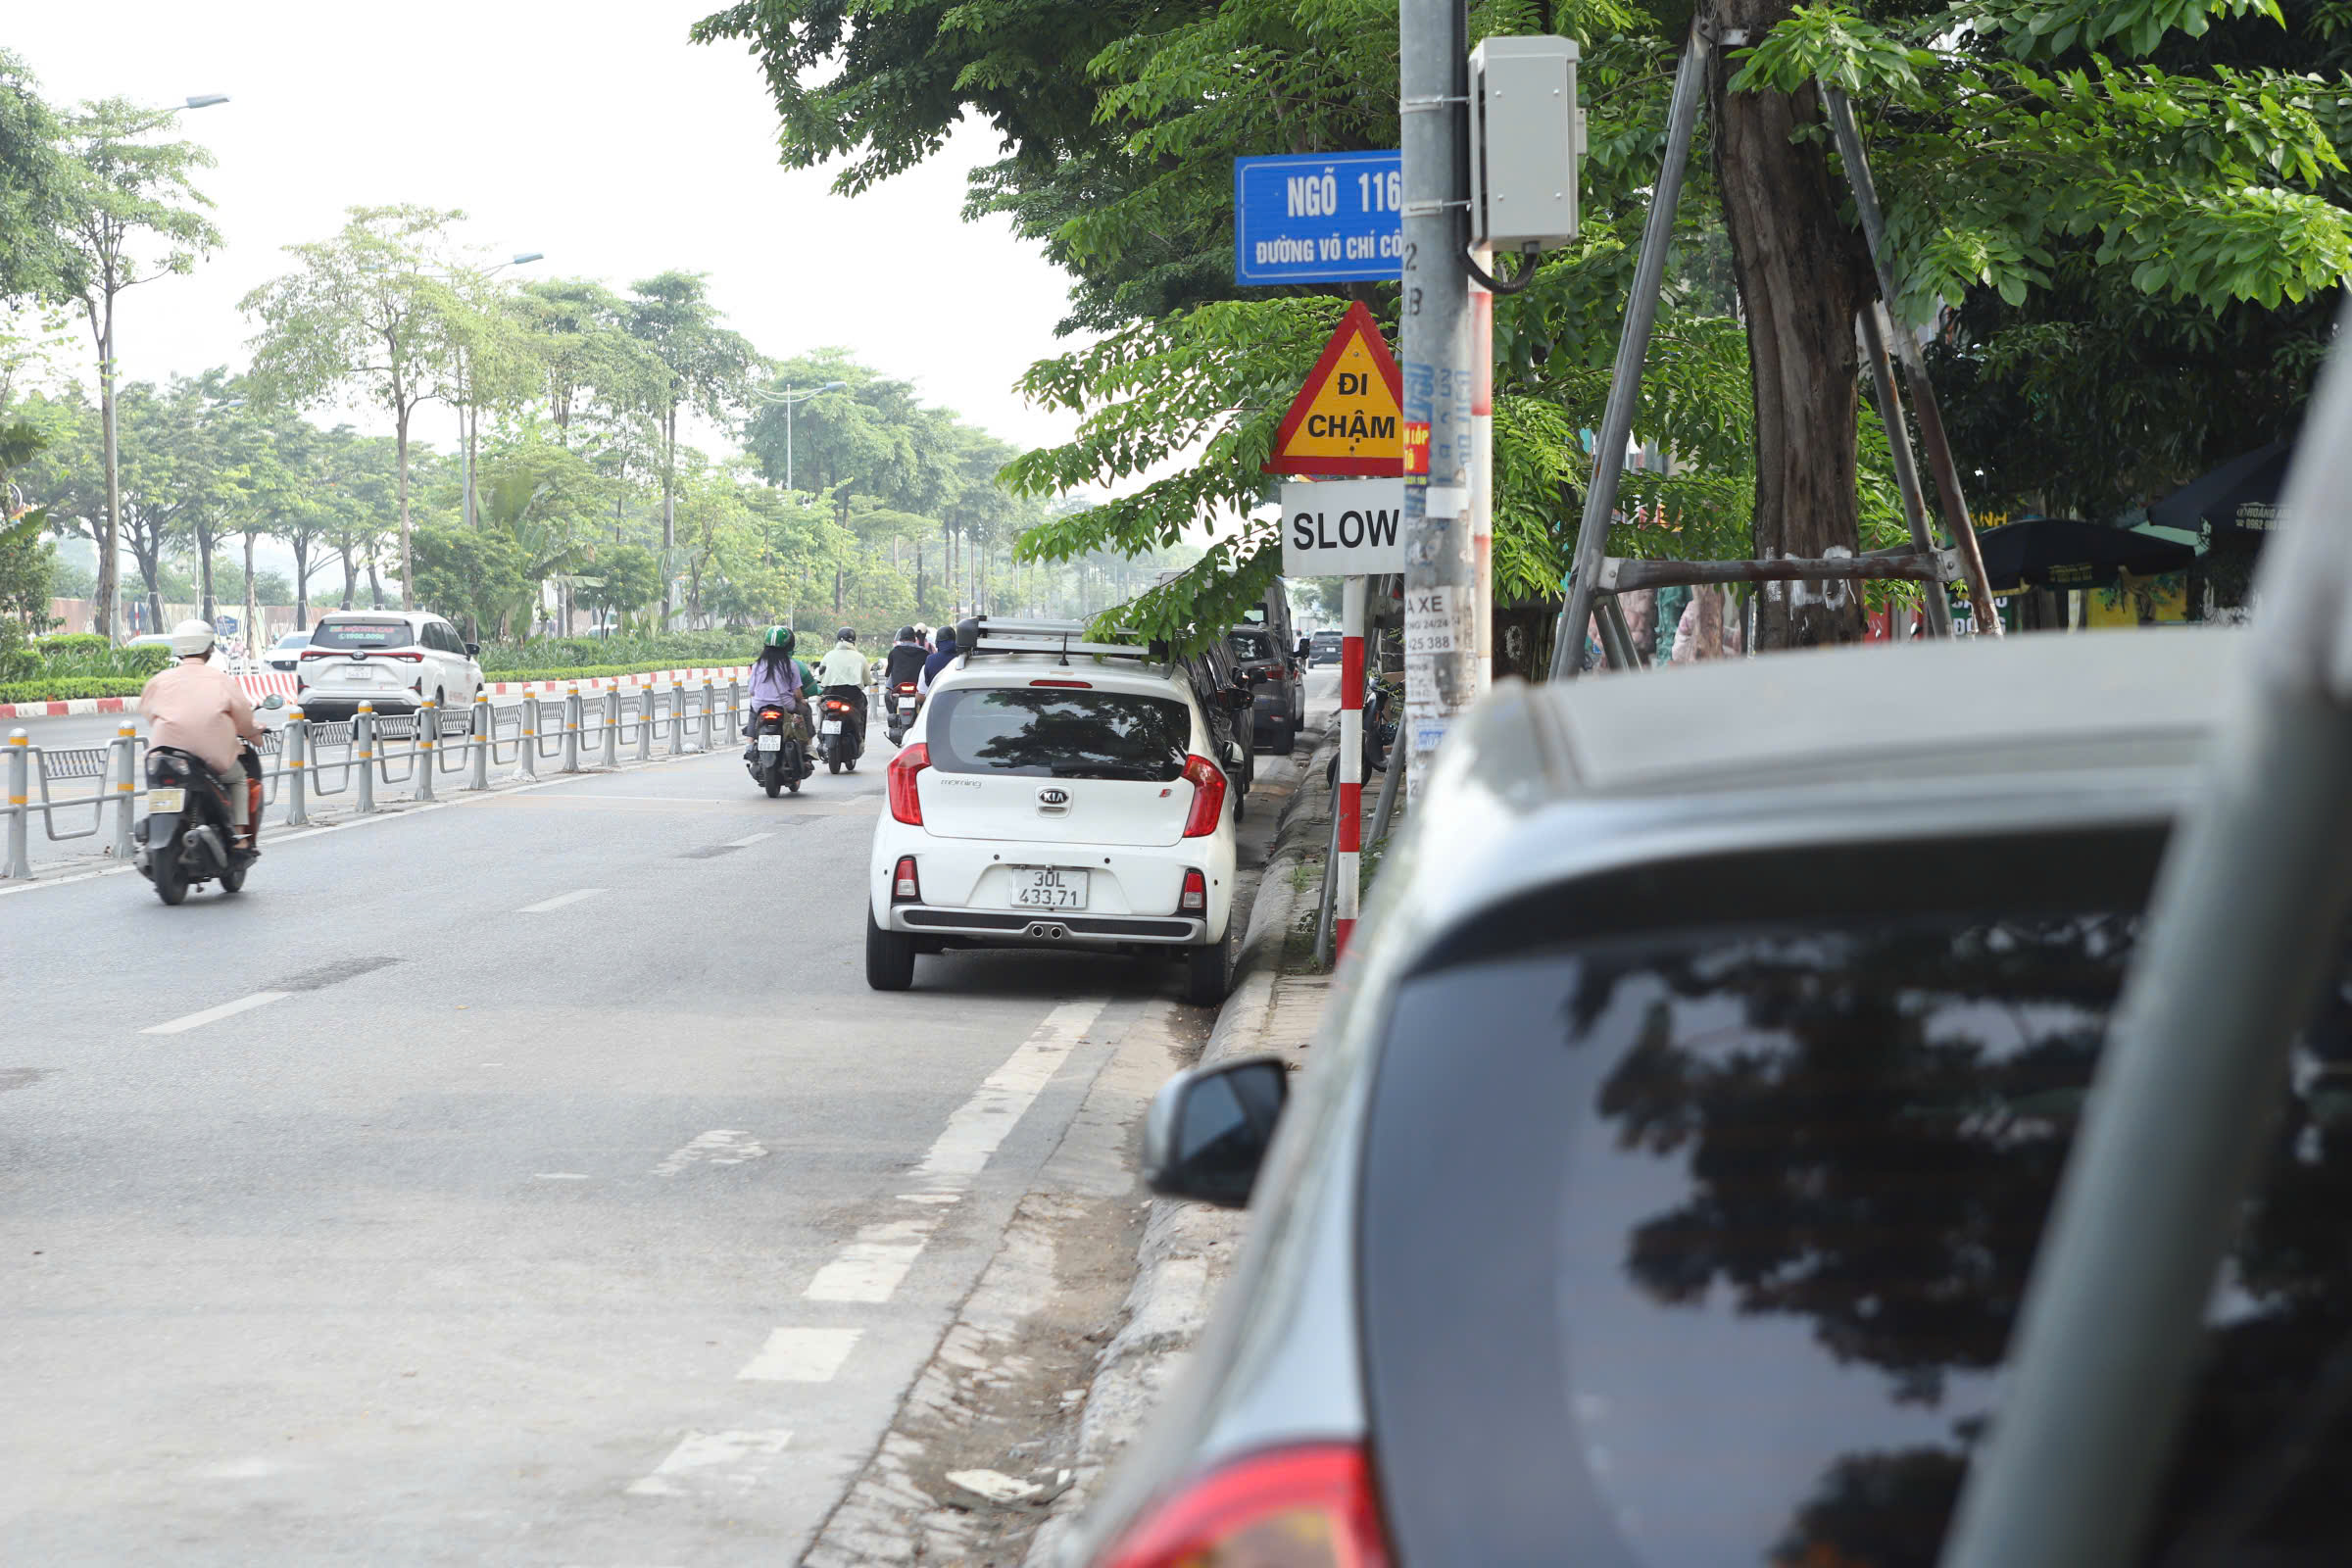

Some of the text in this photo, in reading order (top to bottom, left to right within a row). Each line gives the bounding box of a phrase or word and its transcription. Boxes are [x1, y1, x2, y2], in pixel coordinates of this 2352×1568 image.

[1287, 167, 1401, 218] NGÕ 116
[1255, 234, 1314, 264] ĐƯỜNG
[1319, 232, 1341, 262] VÕ
[1347, 229, 1375, 259] CHÍ
[1338, 372, 1368, 396] ĐI
[1307, 410, 1396, 443] CHẬM
[1293, 509, 1400, 550] SLOW
[1419, 596, 1443, 613] XE
[1427, 636, 1450, 650] 388
[1043, 792, 1064, 802] KIA
[1034, 871, 1065, 887] 30L
[1019, 889, 1077, 906] 433.71
